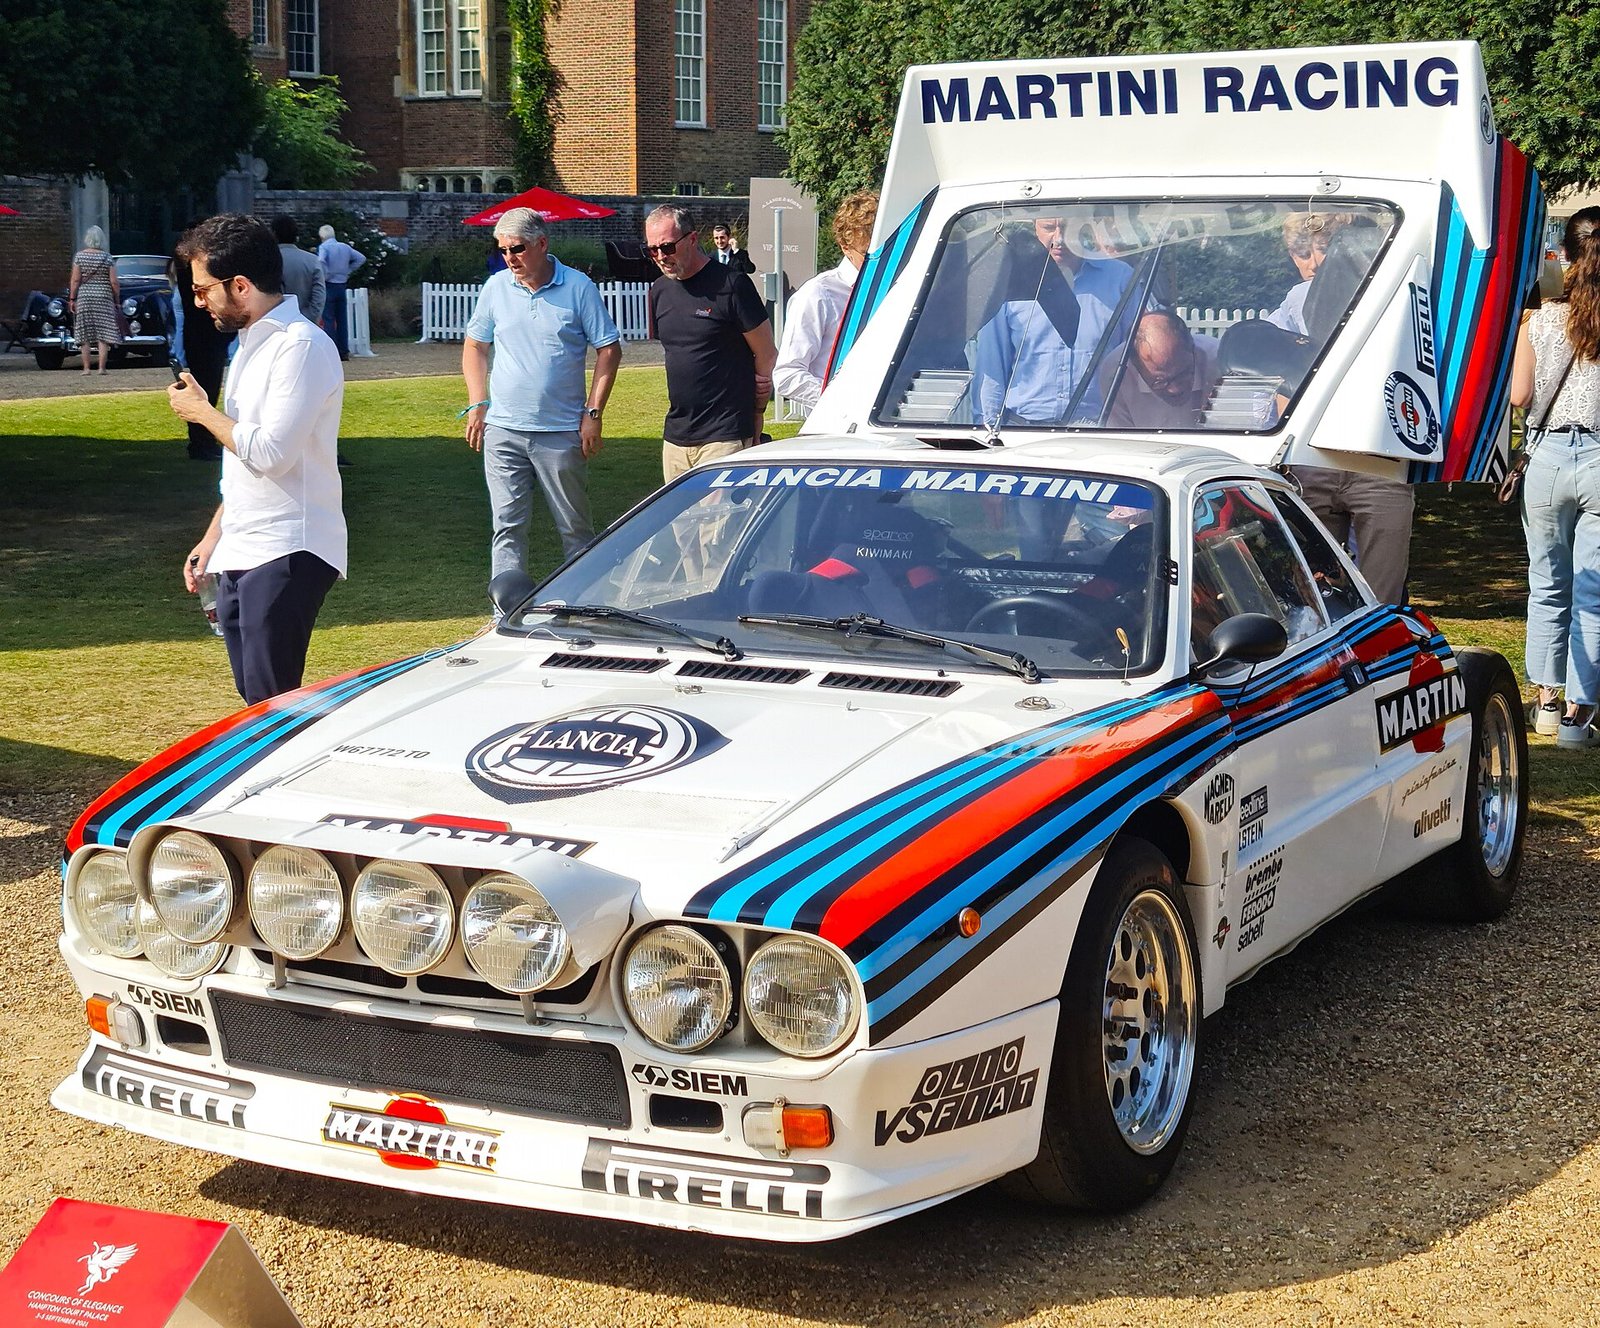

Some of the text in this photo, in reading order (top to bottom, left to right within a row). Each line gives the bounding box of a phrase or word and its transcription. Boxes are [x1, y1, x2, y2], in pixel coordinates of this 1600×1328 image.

[921, 57, 1459, 124] MARTINI RACING
[1408, 281, 1435, 378] PIRELLI
[1403, 387, 1418, 440] MARTINI
[709, 468, 1119, 504] LANCIA MARTINI
[863, 529, 914, 541] sparco
[856, 547, 913, 559] KIWIMAKI
[533, 730, 637, 757] LANCIA
[1413, 798, 1451, 839] olivetti
[1245, 858, 1283, 893] brembo
[1243, 892, 1275, 927] FERODO
[1237, 915, 1265, 953] sabelt
[151, 989, 206, 1018] SIEM
[82, 1043, 256, 1130] PIRELLI
[671, 1069, 749, 1097] SIEM
[922, 1045, 1019, 1096] OLIO
[328, 1110, 500, 1166] MARTINI
[581, 1136, 832, 1219] PIRELLI
[27, 1290, 125, 1314] CONCOURS OF ELEGANCE
[27, 1301, 110, 1322] HAMPTON COURT PALACE
[44, 1314, 75, 1325] SEPTEMBER
